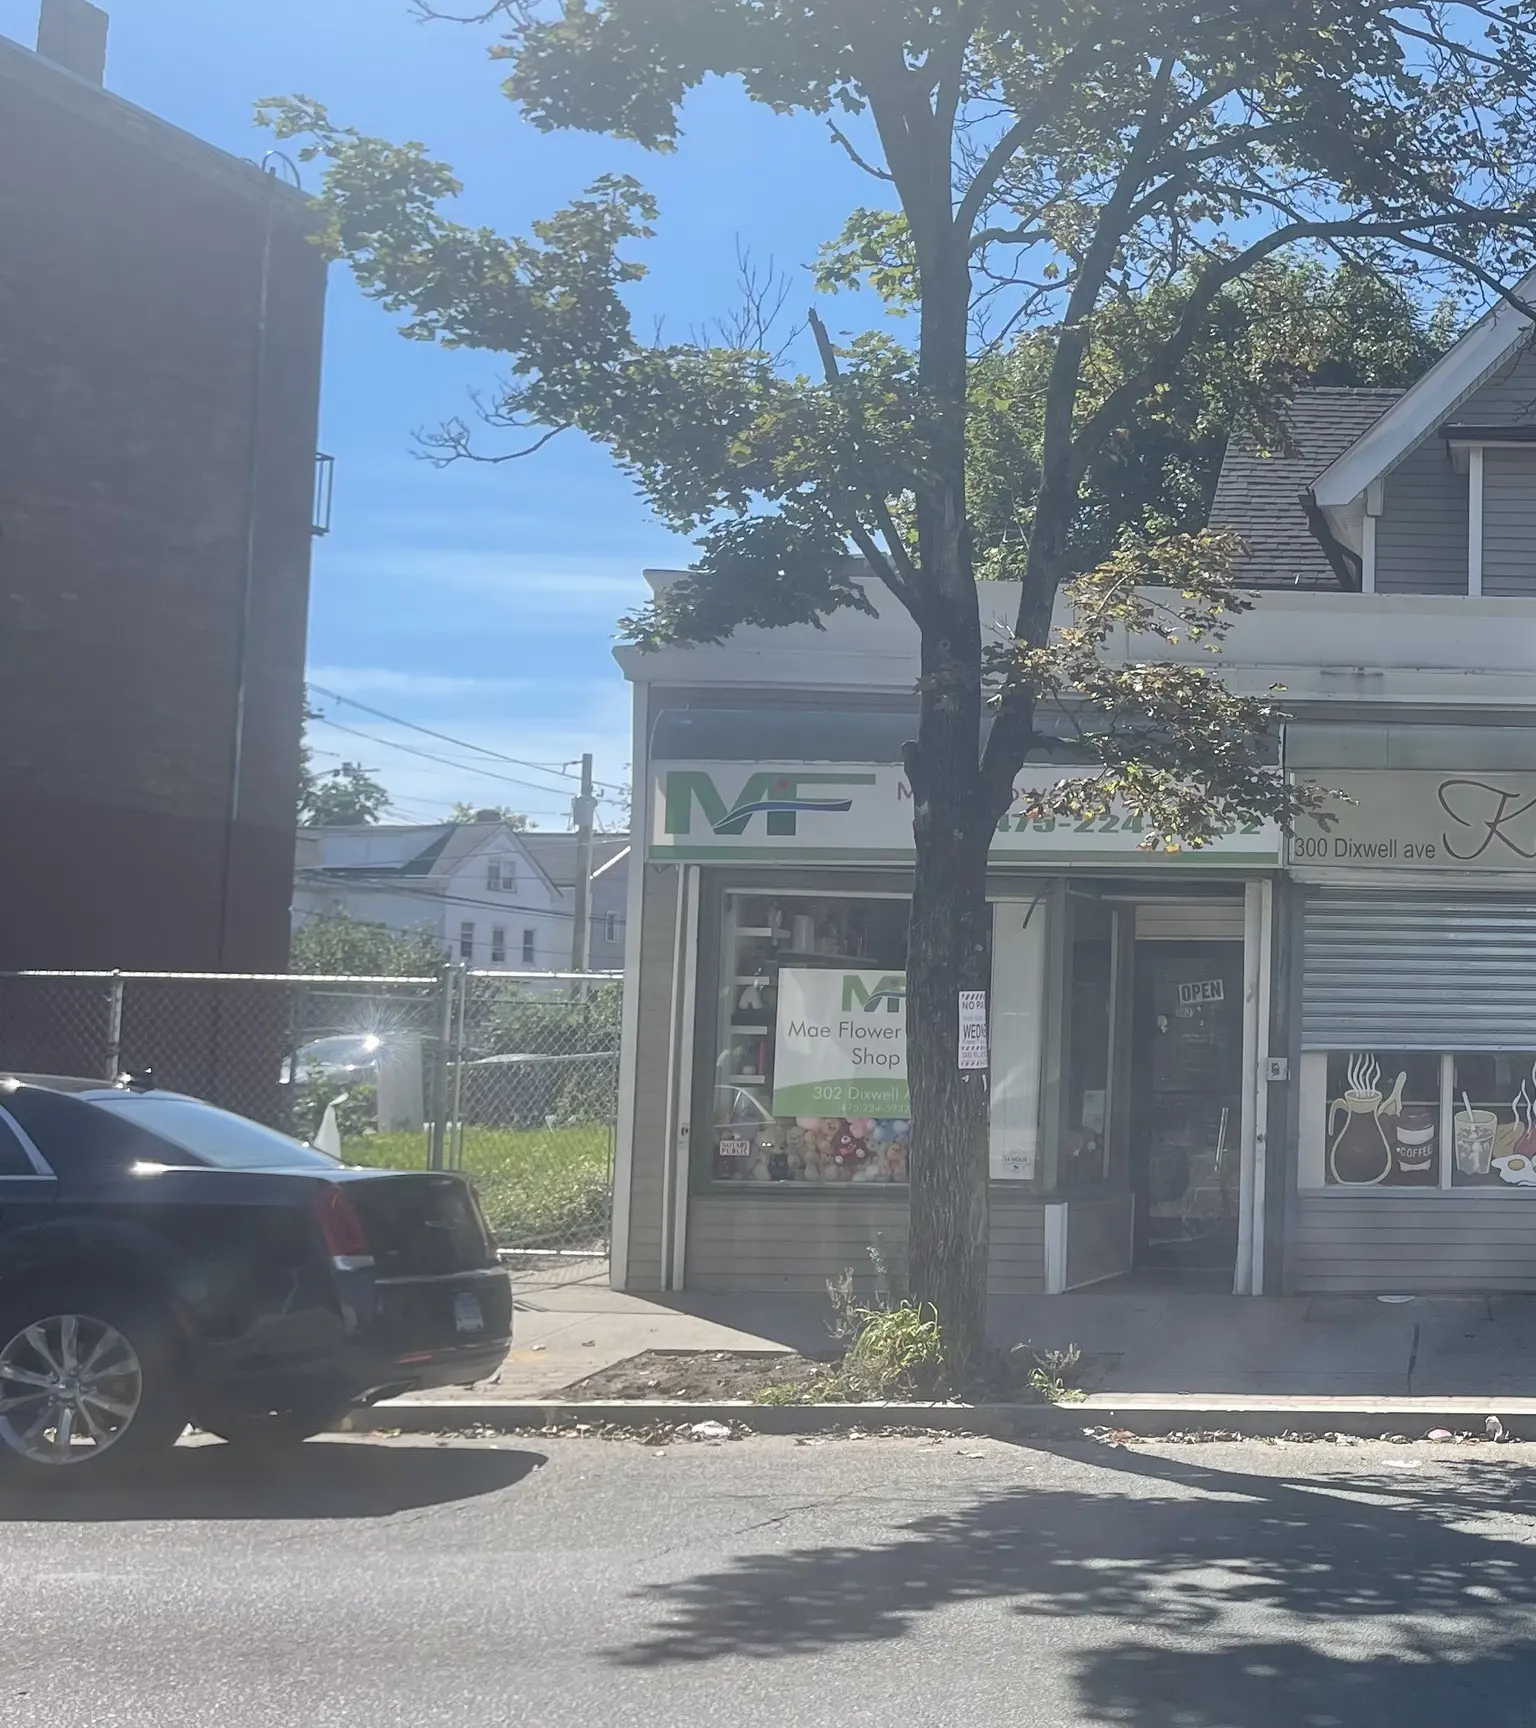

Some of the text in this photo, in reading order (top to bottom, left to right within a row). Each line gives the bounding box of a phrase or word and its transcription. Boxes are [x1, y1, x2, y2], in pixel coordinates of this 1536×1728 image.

[1294, 837, 1436, 859] 300 Dixwell ave
[1181, 981, 1222, 1001] OPEN
[962, 1001, 975, 1010] NO
[788, 1021, 901, 1039] Mae Flower
[851, 1048, 900, 1070] Shop
[813, 1086, 842, 1100] 302
[848, 1086, 899, 1101] Dixwell
[1400, 1145, 1433, 1158] COFFEE
